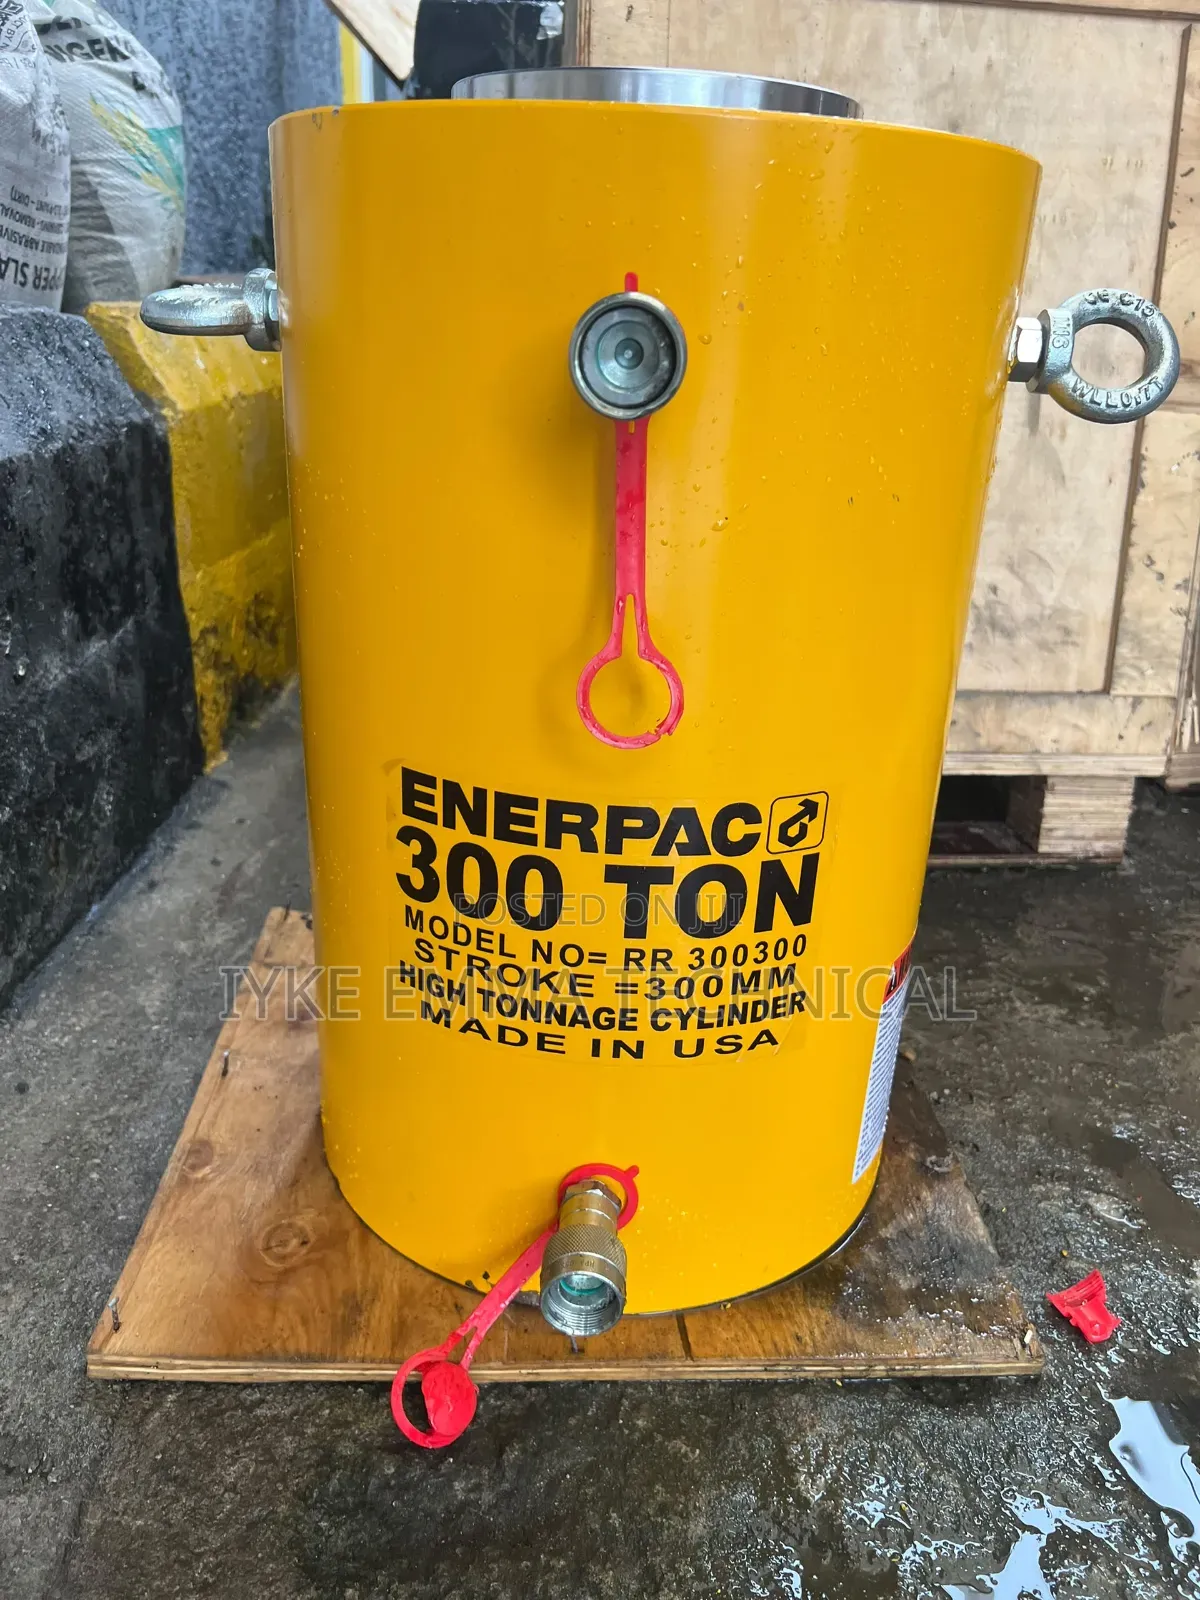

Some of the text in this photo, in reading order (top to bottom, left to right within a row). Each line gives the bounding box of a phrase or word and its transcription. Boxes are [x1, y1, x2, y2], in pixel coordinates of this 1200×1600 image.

[401, 766, 762, 857] ENERPAC
[395, 825, 820, 940] 300 TON
[404, 904, 808, 971] MODEL NO= RR 300300
[414, 938, 595, 998] STROKE
[399, 960, 807, 1032] HIGH TONNAGE CYLINDER
[420, 1000, 780, 1059] MADE IN USA
